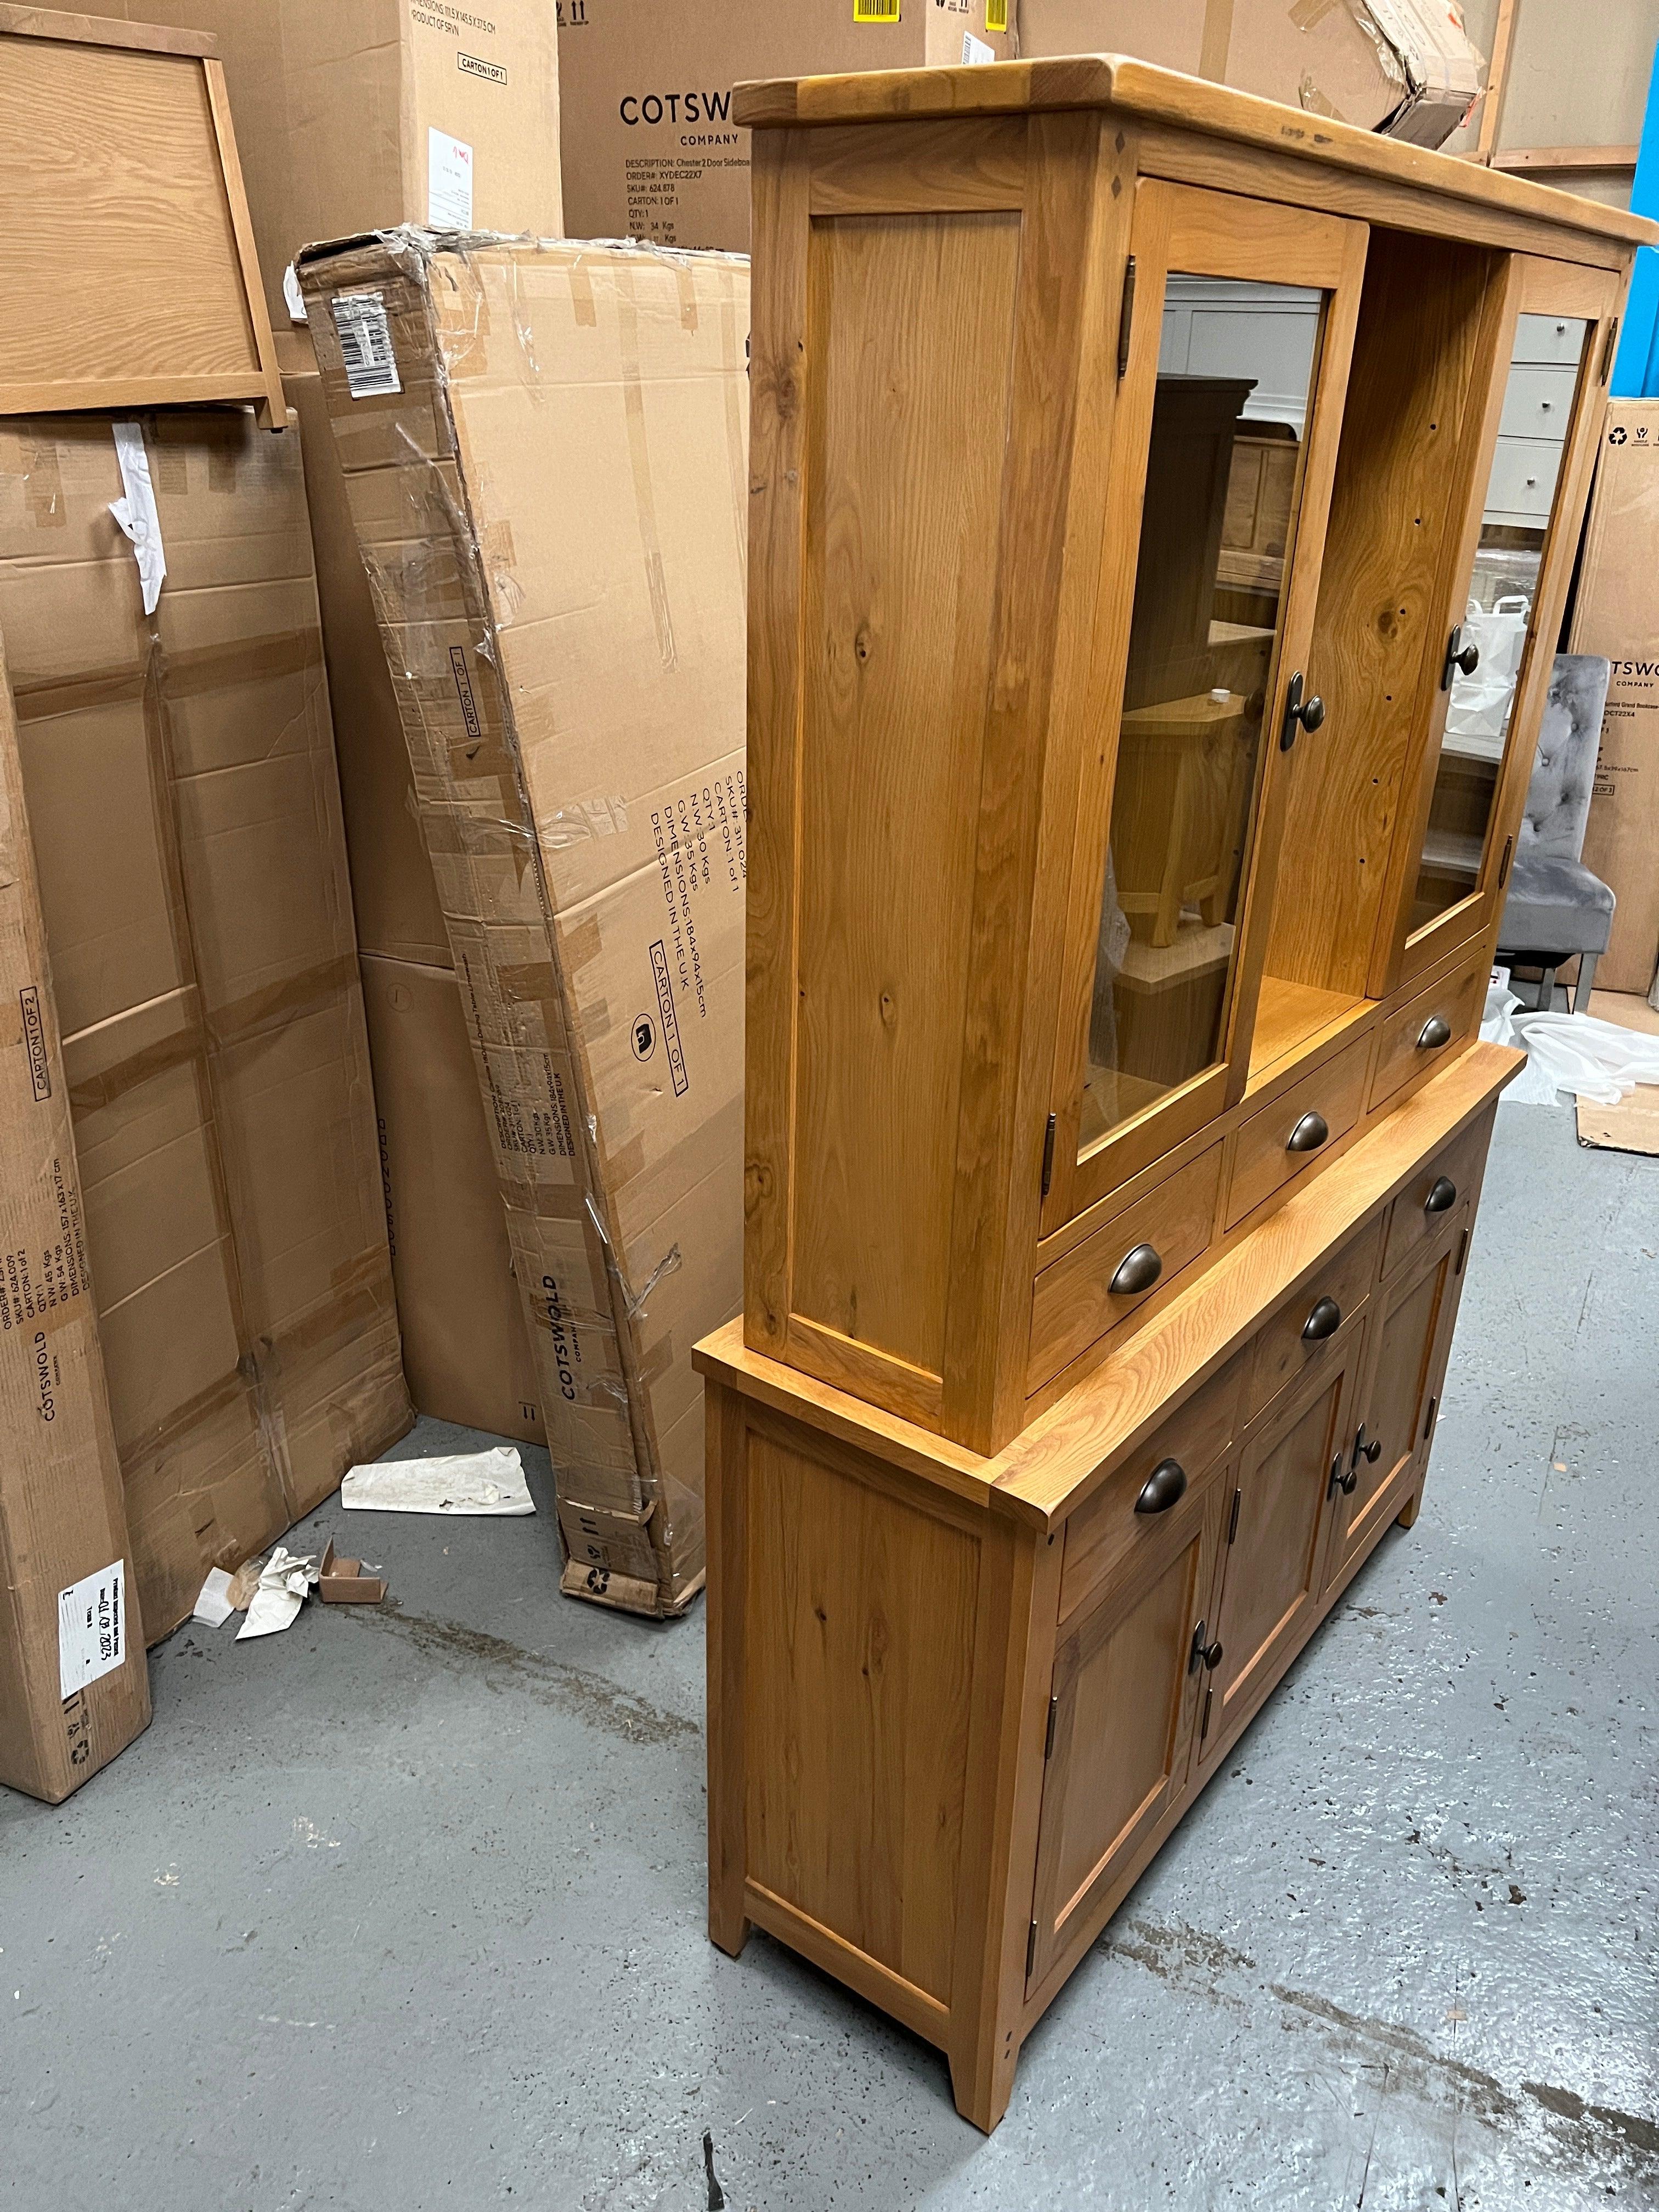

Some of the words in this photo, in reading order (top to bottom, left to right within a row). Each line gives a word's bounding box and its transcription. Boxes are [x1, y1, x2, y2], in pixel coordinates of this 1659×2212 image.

[462, 58, 487, 75] CARTON
[491, 69, 499, 78] OF
[680, 134, 738, 145] COMPANY
[702, 159, 706, 167] 2
[707, 158, 723, 167] Door
[664, 196, 674, 205] OF
[455, 661, 465, 676] OF
[462, 690, 477, 733] CARTON
[689, 862, 698, 891] Kgs
[702, 856, 710, 884] Kgs
[730, 867, 738, 882] of
[651, 812, 674, 903] DESIGNED
[668, 906, 678, 924] IN
[673, 926, 684, 961] THE
[25, 996, 34, 1005] 2
[26, 1008, 37, 1025] OF
[654, 951, 674, 1029] CARTON
[672, 1049, 682, 1073] OF
[677, 1079, 684, 1087] 1
[556, 1087, 565, 1104] THE
[560, 1104, 568, 1114] IN
[562, 1114, 575, 1156] DESIGNED
[54, 1159, 60, 1173] cm
[58, 1192, 66, 1207] 163
[60, 1216, 69, 1231] 157
[71, 1207, 80, 1228] THE
[74, 1228, 81, 1239] IN
[18, 1258, 27, 1266] of
[43, 1250, 52, 1268] Kgs
[55, 1245, 64, 1263] Kgs
[542, 1275, 575, 1400] COTSWOLD
[35, 1332, 55, 1421] COTSWOLD
